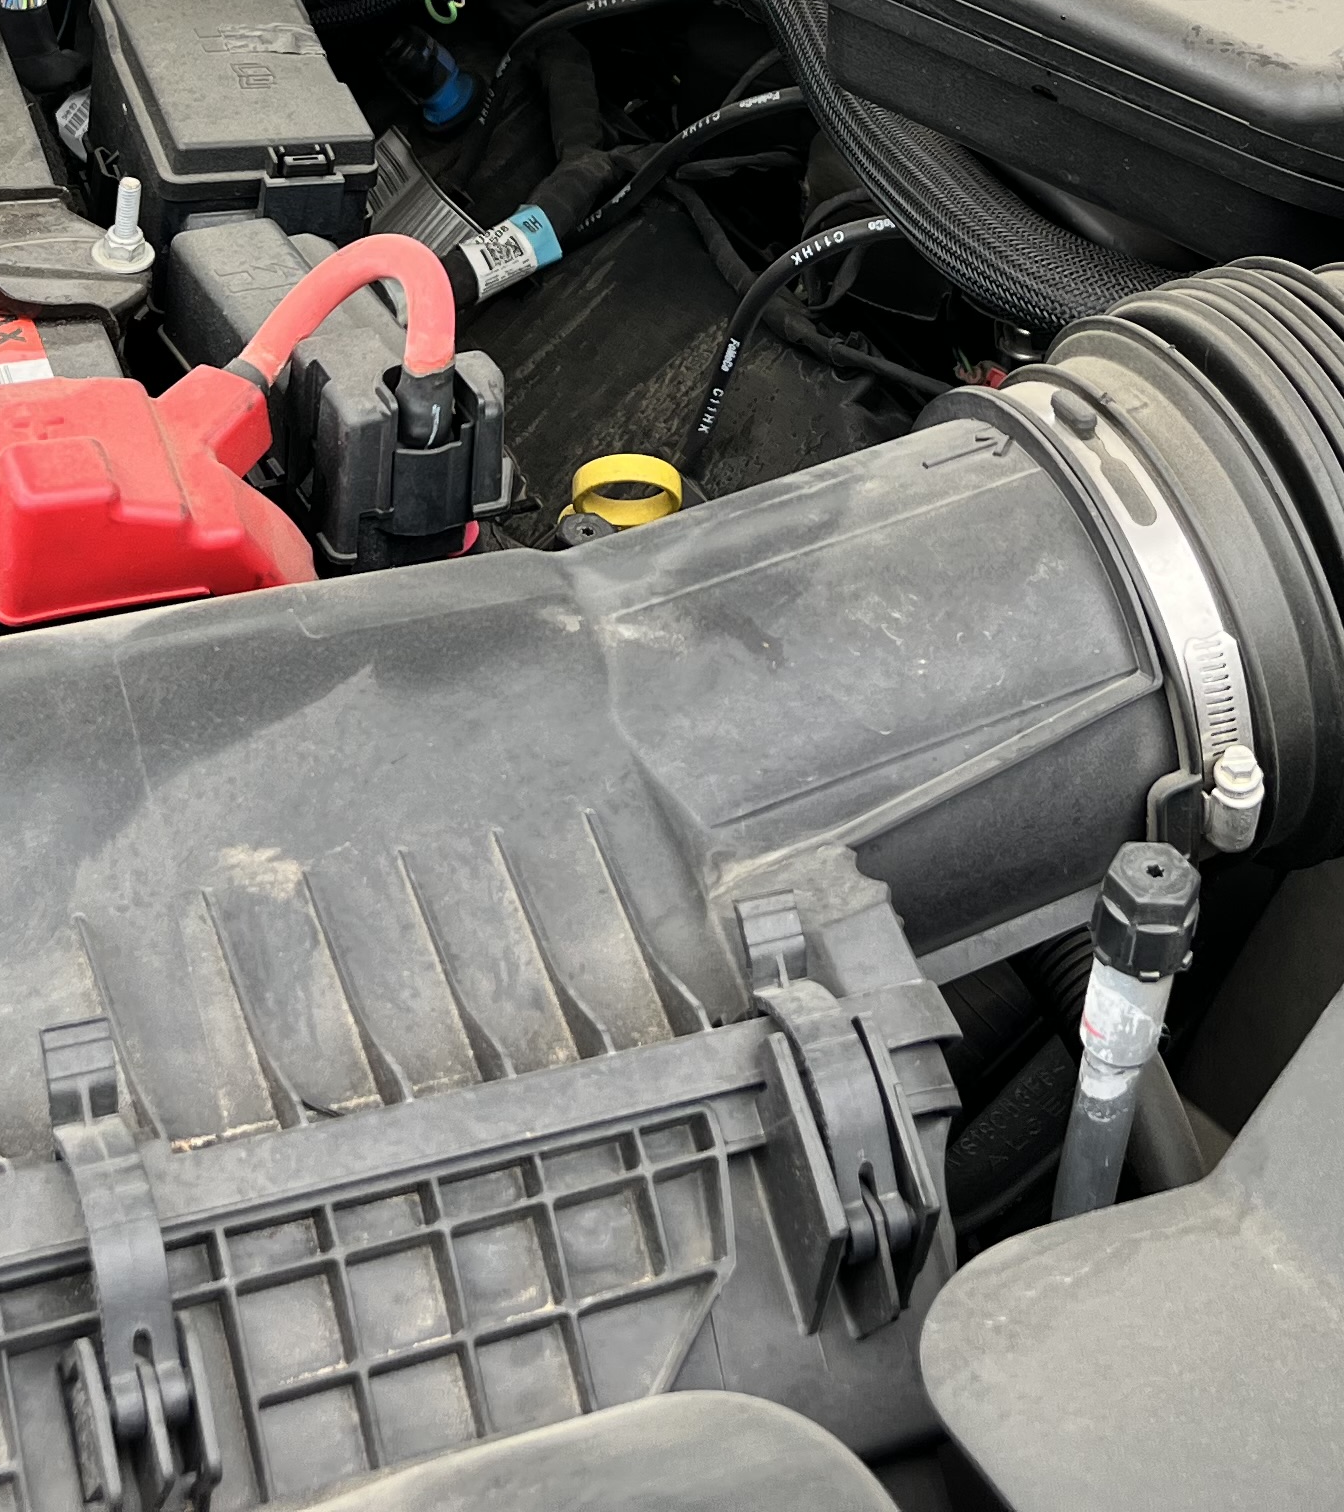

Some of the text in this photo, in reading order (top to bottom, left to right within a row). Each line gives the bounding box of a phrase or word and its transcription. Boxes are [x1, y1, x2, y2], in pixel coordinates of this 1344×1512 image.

[681, 110, 721, 140] C11HK
[790, 230, 845, 266] C11HK
[698, 387, 725, 434] C11HK
